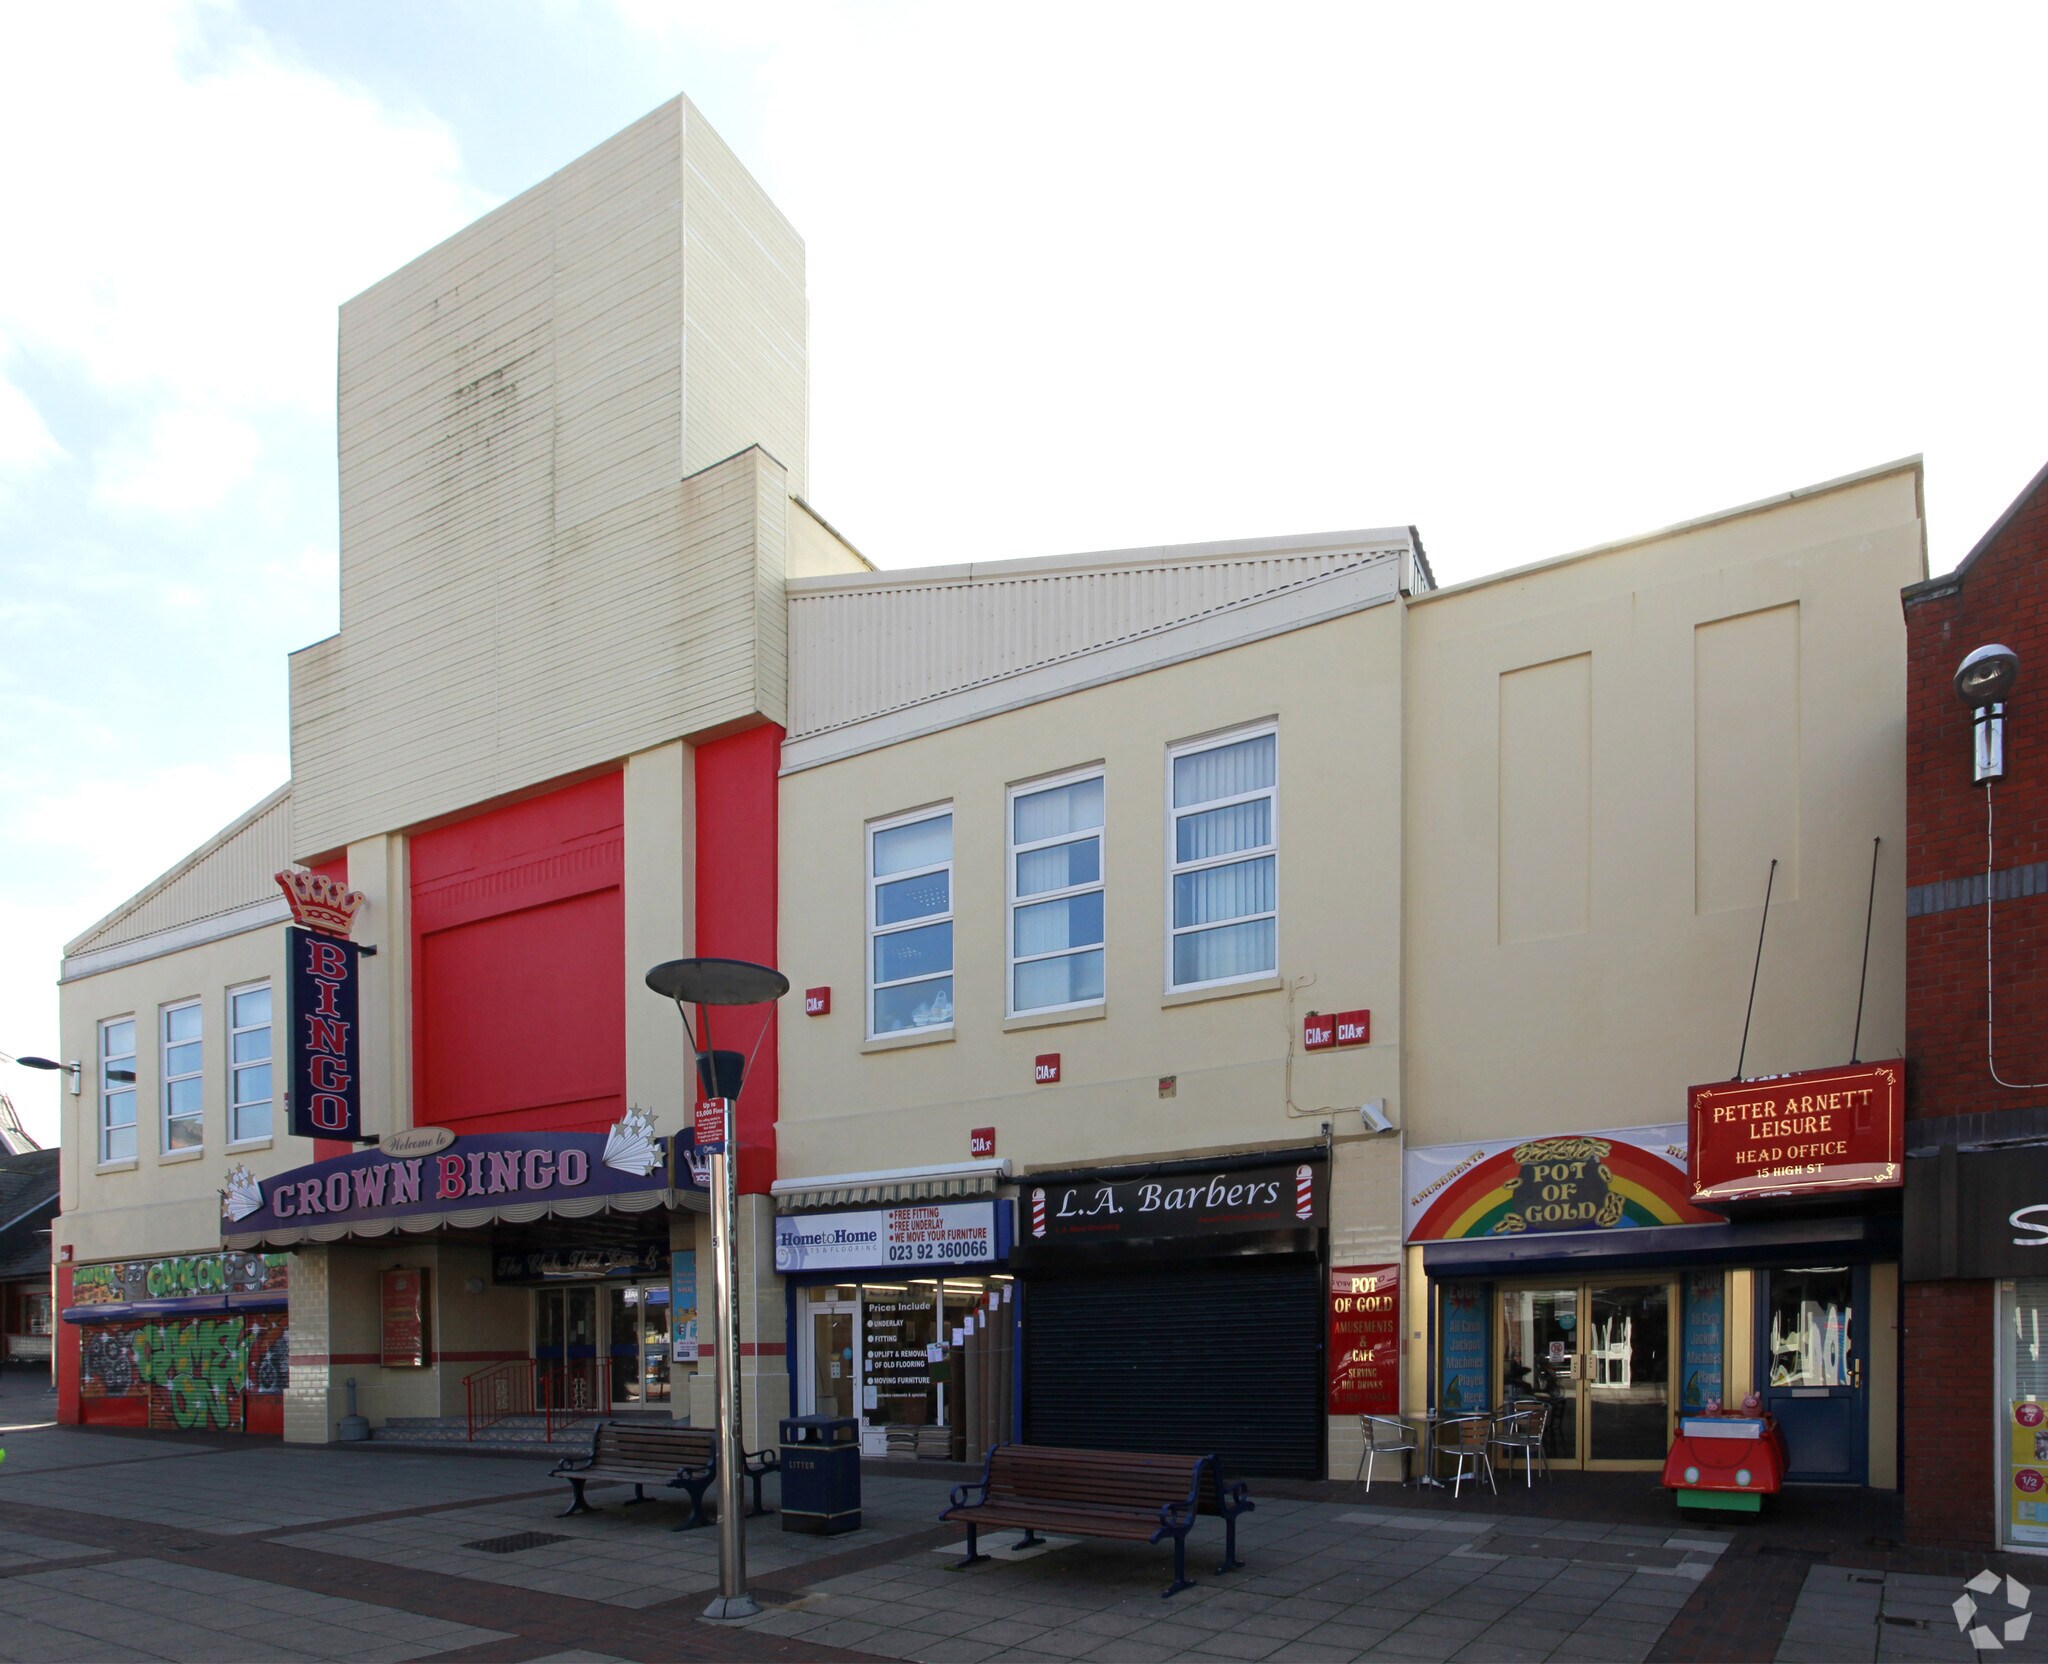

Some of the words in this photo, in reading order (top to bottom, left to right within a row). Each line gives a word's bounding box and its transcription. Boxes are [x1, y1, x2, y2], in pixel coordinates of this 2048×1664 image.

[306, 938, 352, 1130] BINGO
[1305, 1027, 1321, 1045] CIA
[1338, 1023, 1355, 1040] CIA
[1036, 1065, 1049, 1080] CIA
[1713, 1100, 1776, 1124] PETER
[1784, 1088, 1873, 1115] ARNETT
[1750, 1115, 1832, 1141] LEISURE
[389, 1137, 433, 1151] Welcome
[436, 1132, 446, 1145] to
[972, 1138, 985, 1152] CIA
[1735, 1147, 1782, 1164] HEAD
[1787, 1141, 1848, 1160] OFFICE
[1411, 1150, 1485, 1207] AMUSEMENTS
[1533, 1161, 1587, 1183] POT
[1757, 1168, 1770, 1179] 15
[1773, 1165, 1802, 1177] HIGH
[1806, 1163, 1824, 1174] ST
[272, 1158, 423, 1218] CROWN
[436, 1149, 589, 1200] BINGO
[1055, 1186, 1124, 1218] L.A.
[1138, 1174, 1280, 1212] Barbers
[1541, 1182, 1578, 1202] OF
[894, 1209, 911, 1220] FREE
[912, 1208, 939, 1219] FITTING
[1524, 1200, 1597, 1222] GOLD
[894, 1221, 910, 1231] FREE
[911, 1219, 944, 1230] UNDERLAY
[895, 1233, 905, 1243] WE
[906, 1232, 926, 1242] MOVE
[926, 1231, 947, 1241] YOUR
[947, 1228, 987, 1240] FURNITURE
[889, 1245, 913, 1261] 023
[917, 1243, 933, 1259] 92
[937, 1241, 987, 1258] 360066
[147, 1257, 197, 1297] GAME
[197, 1257, 224, 1293] ON
[1351, 1277, 1378, 1294] POT
[869, 1303, 896, 1312] Prices
[898, 1302, 931, 1311] Include
[1334, 1298, 1352, 1313] OF
[1356, 1296, 1393, 1313] GOLD
[874, 1320, 904, 1328] UNDERLAY
[1334, 1320, 1394, 1333] AMUSEMENTS
[874, 1335, 898, 1343] FITTING
[1360, 1336, 1367, 1347] &
[874, 1350, 894, 1358] UPLIFT
[894, 1350, 899, 1358] &
[901, 1349, 928, 1357] REMOVAL
[1352, 1350, 1374, 1362] CAFE
[874, 1361, 882, 1369] OF
[883, 1361, 895, 1369] OLD
[896, 1360, 925, 1368] FLOORING
[1446, 1357, 1484, 1369] Machines
[874, 1377, 896, 1385] MOVING
[897, 1376, 930, 1384] FURNITURE
[1348, 1368, 1377, 1378] SERVING
[1357, 1380, 1383, 1390] DRINKS
[1458, 1374, 1484, 1388] Played
[789, 1461, 816, 1470] LITTER
[2021, 1475, 2037, 1487] 1/2
